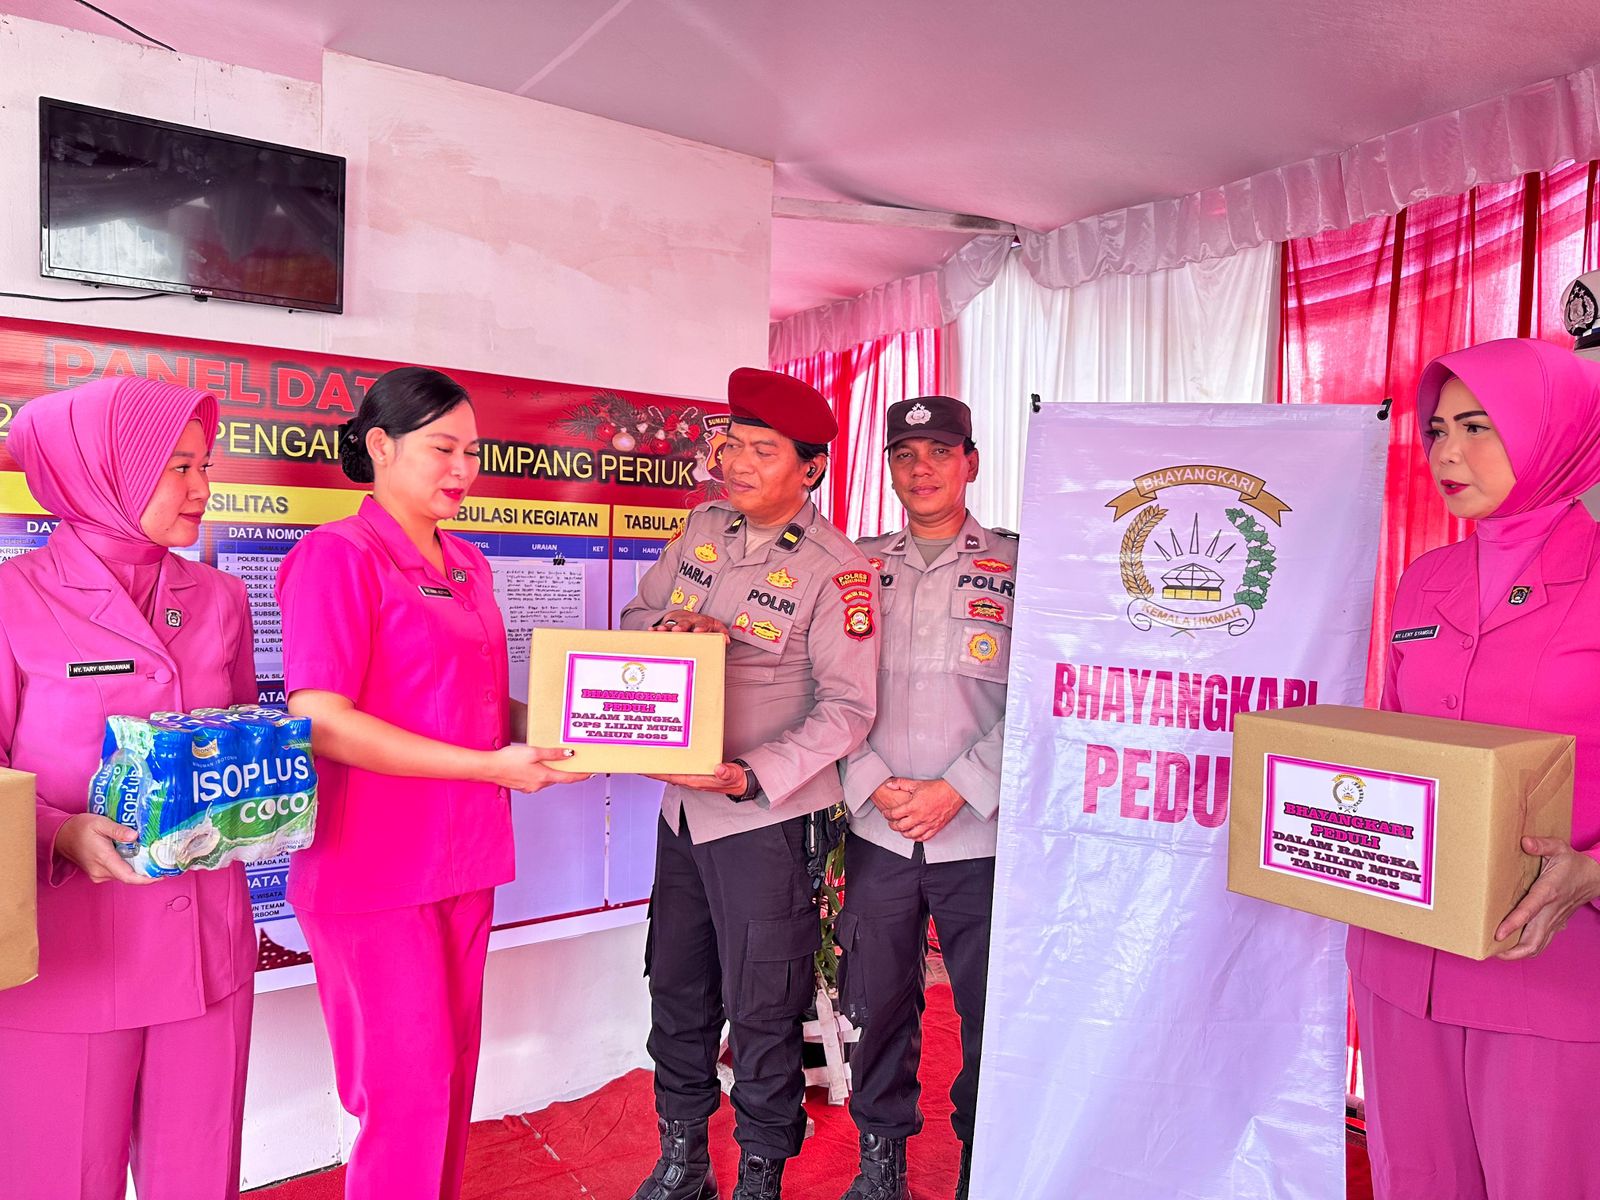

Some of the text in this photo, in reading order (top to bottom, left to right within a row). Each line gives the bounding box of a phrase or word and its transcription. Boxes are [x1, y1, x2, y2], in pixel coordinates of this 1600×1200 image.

[53, 343, 261, 404] PANEL
[477, 443, 593, 479] IMPANG
[601, 456, 694, 486] PERIUK
[1142, 467, 1257, 494] BHAYANGKARI
[522, 508, 599, 527] KEGIATAN
[228, 527, 263, 539] DATA
[531, 543, 557, 551] URAIAN
[592, 545, 605, 553] KET
[957, 574, 1016, 598] POLR
[746, 588, 796, 616] POLRI
[1141, 602, 1242, 626] KEMALA HIKMAH
[581, 688, 679, 703] BHAYANGKARI
[602, 701, 657, 714] PEDULI
[570, 712, 682, 723] DALAM RANGKA
[572, 721, 684, 732] OPS LILIN MUSI
[585, 730, 669, 740] TAHUN 2025
[192, 755, 309, 804] ISOPLUS
[239, 793, 309, 823] COCO
[1284, 802, 1414, 839] BHAYANGKARI
[1311, 823, 1381, 850] PEDULI
[1272, 831, 1419, 870] DALAM RANGKA
[257, 859, 277, 867] MADA
[1274, 843, 1422, 883] OPS LILIN MUSI
[1290, 857, 1400, 890] TAHUN 2025
[256, 891, 283, 899] WISATA
[261, 902, 285, 910] TEMAM
